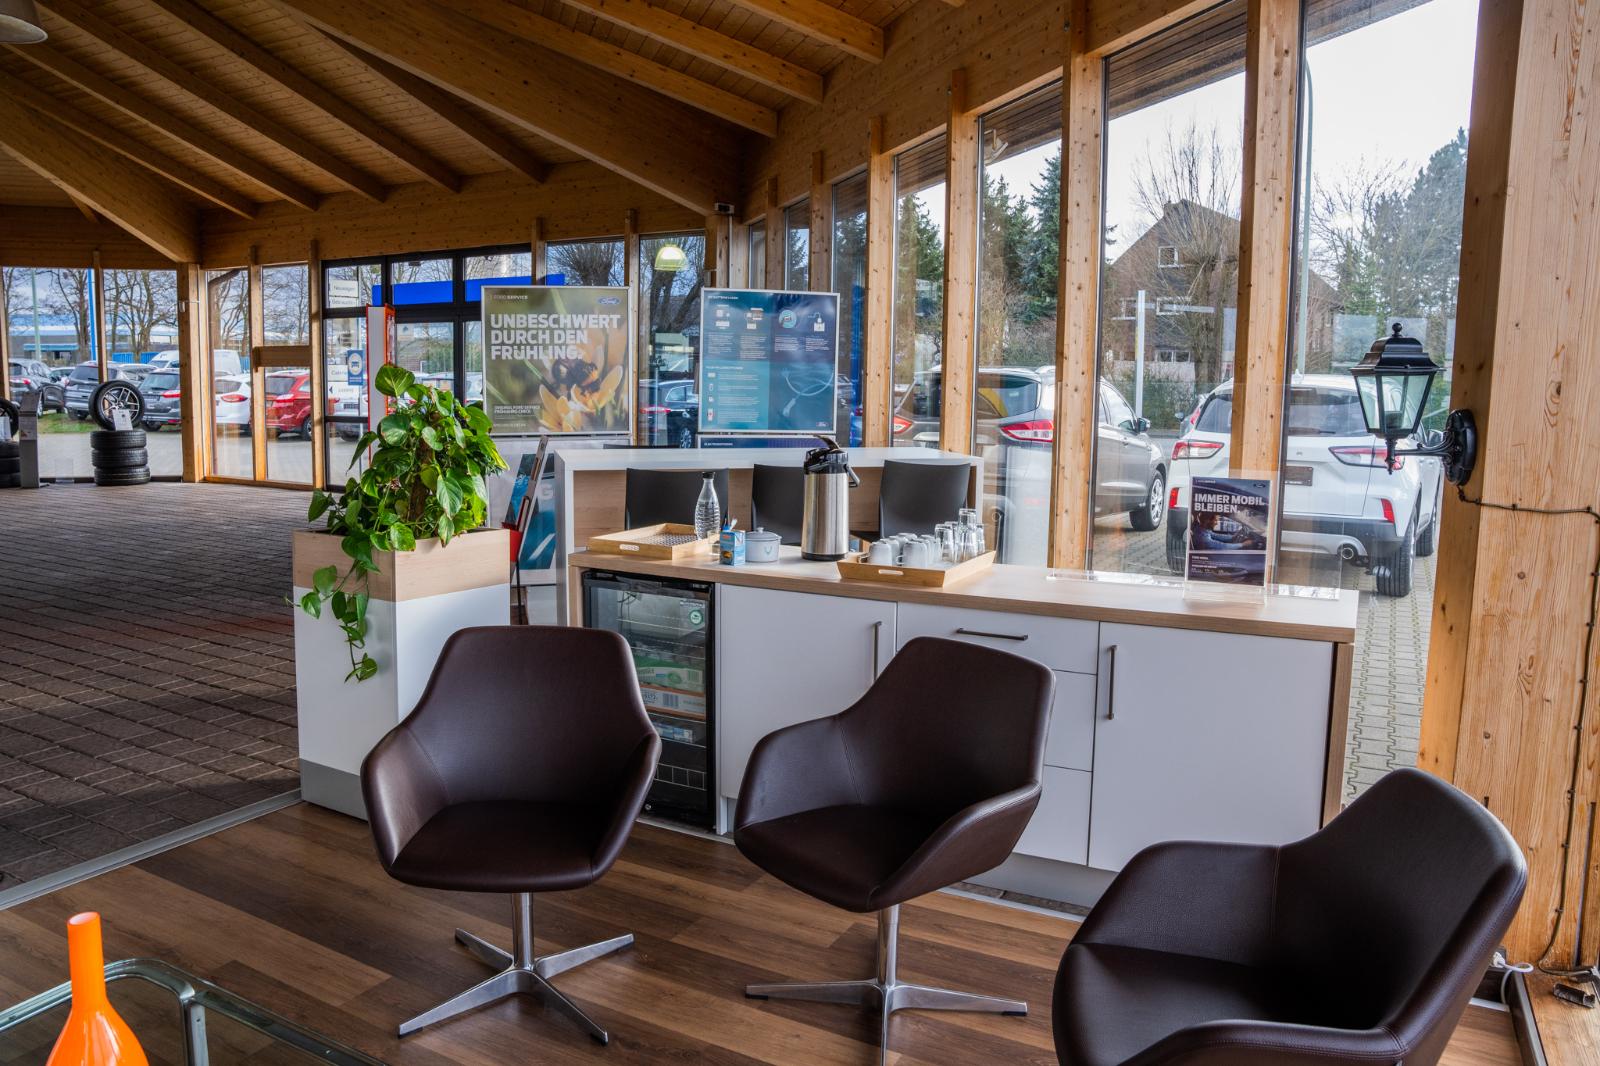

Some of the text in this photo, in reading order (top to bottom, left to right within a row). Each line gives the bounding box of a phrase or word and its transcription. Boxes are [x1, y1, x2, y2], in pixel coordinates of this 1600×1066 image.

[490, 313, 621, 329] UNBESCHWERT
[491, 329, 588, 345] DURCH DEN
[1194, 493, 1265, 505] IMMER MOBIL
[1194, 503, 1241, 513] BLEIBEN.
